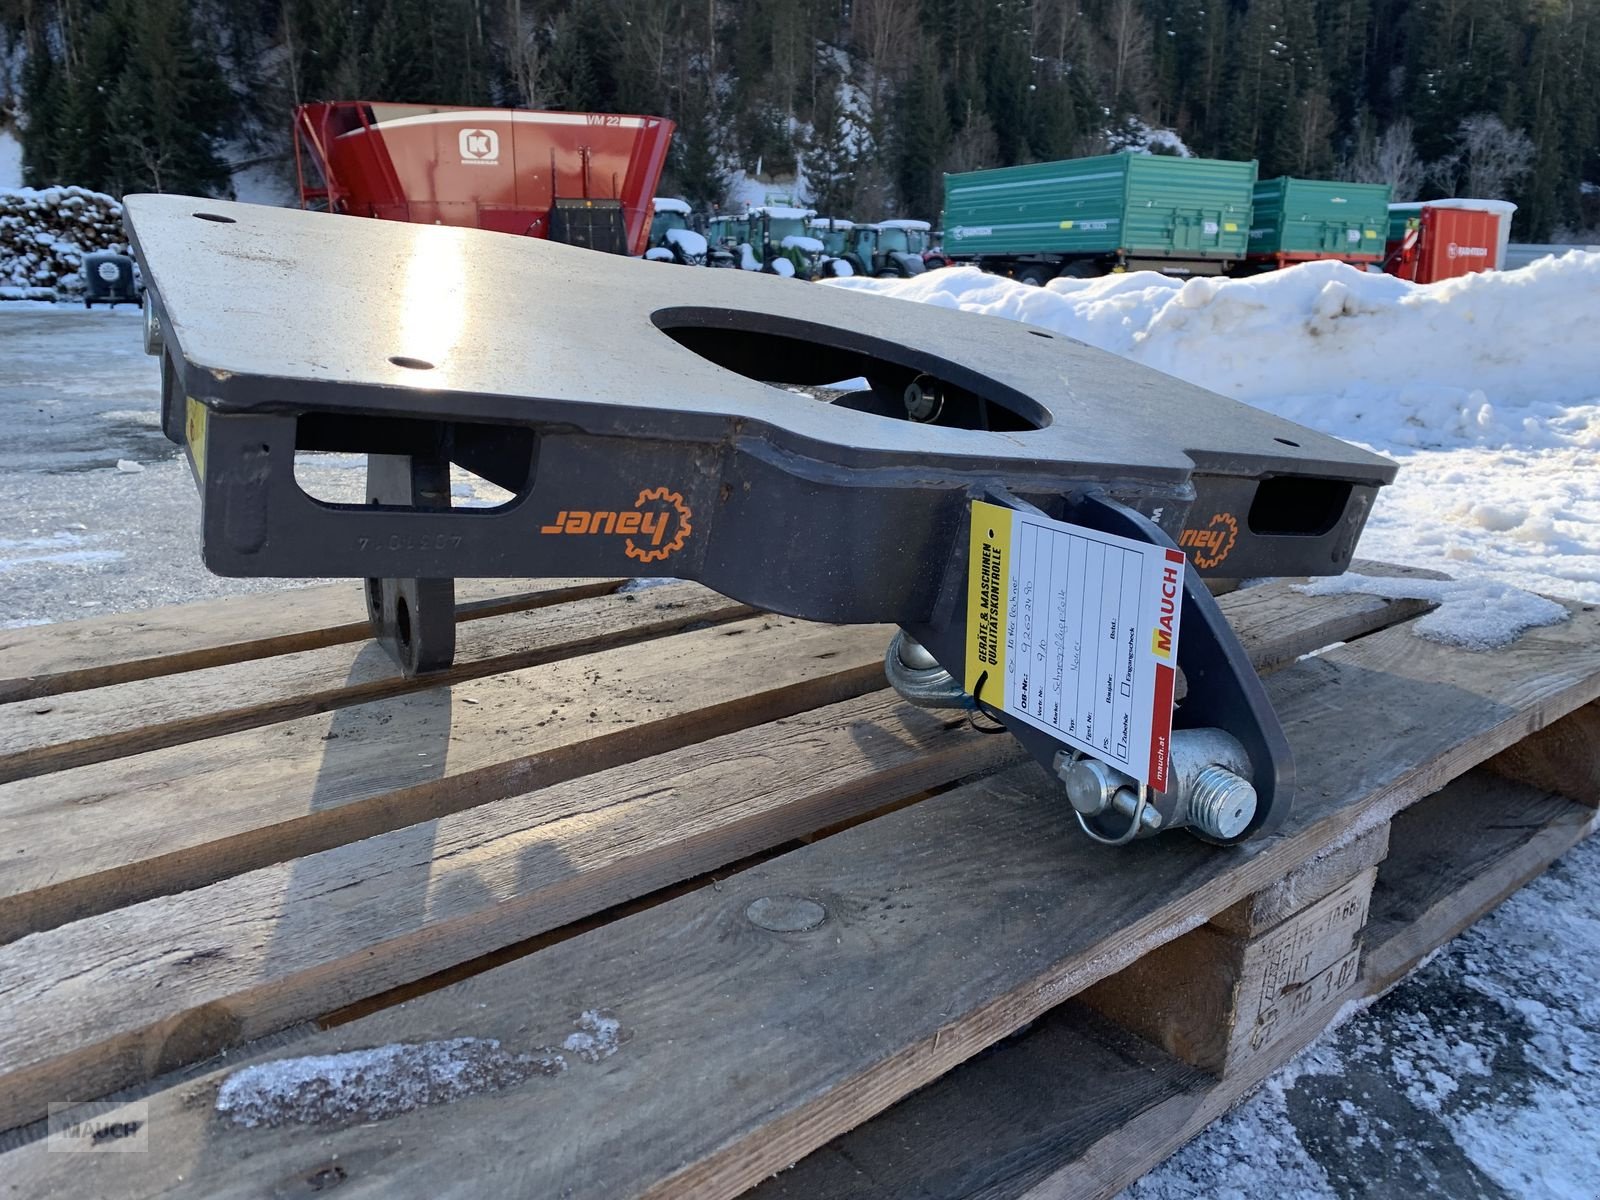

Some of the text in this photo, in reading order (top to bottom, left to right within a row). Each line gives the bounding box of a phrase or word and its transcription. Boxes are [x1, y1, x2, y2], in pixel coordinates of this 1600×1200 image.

[587, 114, 620, 127] VM 22
[541, 511, 671, 546] hauer
[978, 543, 991, 663] GERÄTE & MASCHINEN
[988, 547, 1001, 666] QUALITÄTSKONTROLLE
[1157, 567, 1178, 653] MAUCH
[1121, 627, 1136, 744] Zubehör Eingangscheck
[1156, 735, 1166, 782] mauch.at
[1293, 951, 1313, 982] HT
